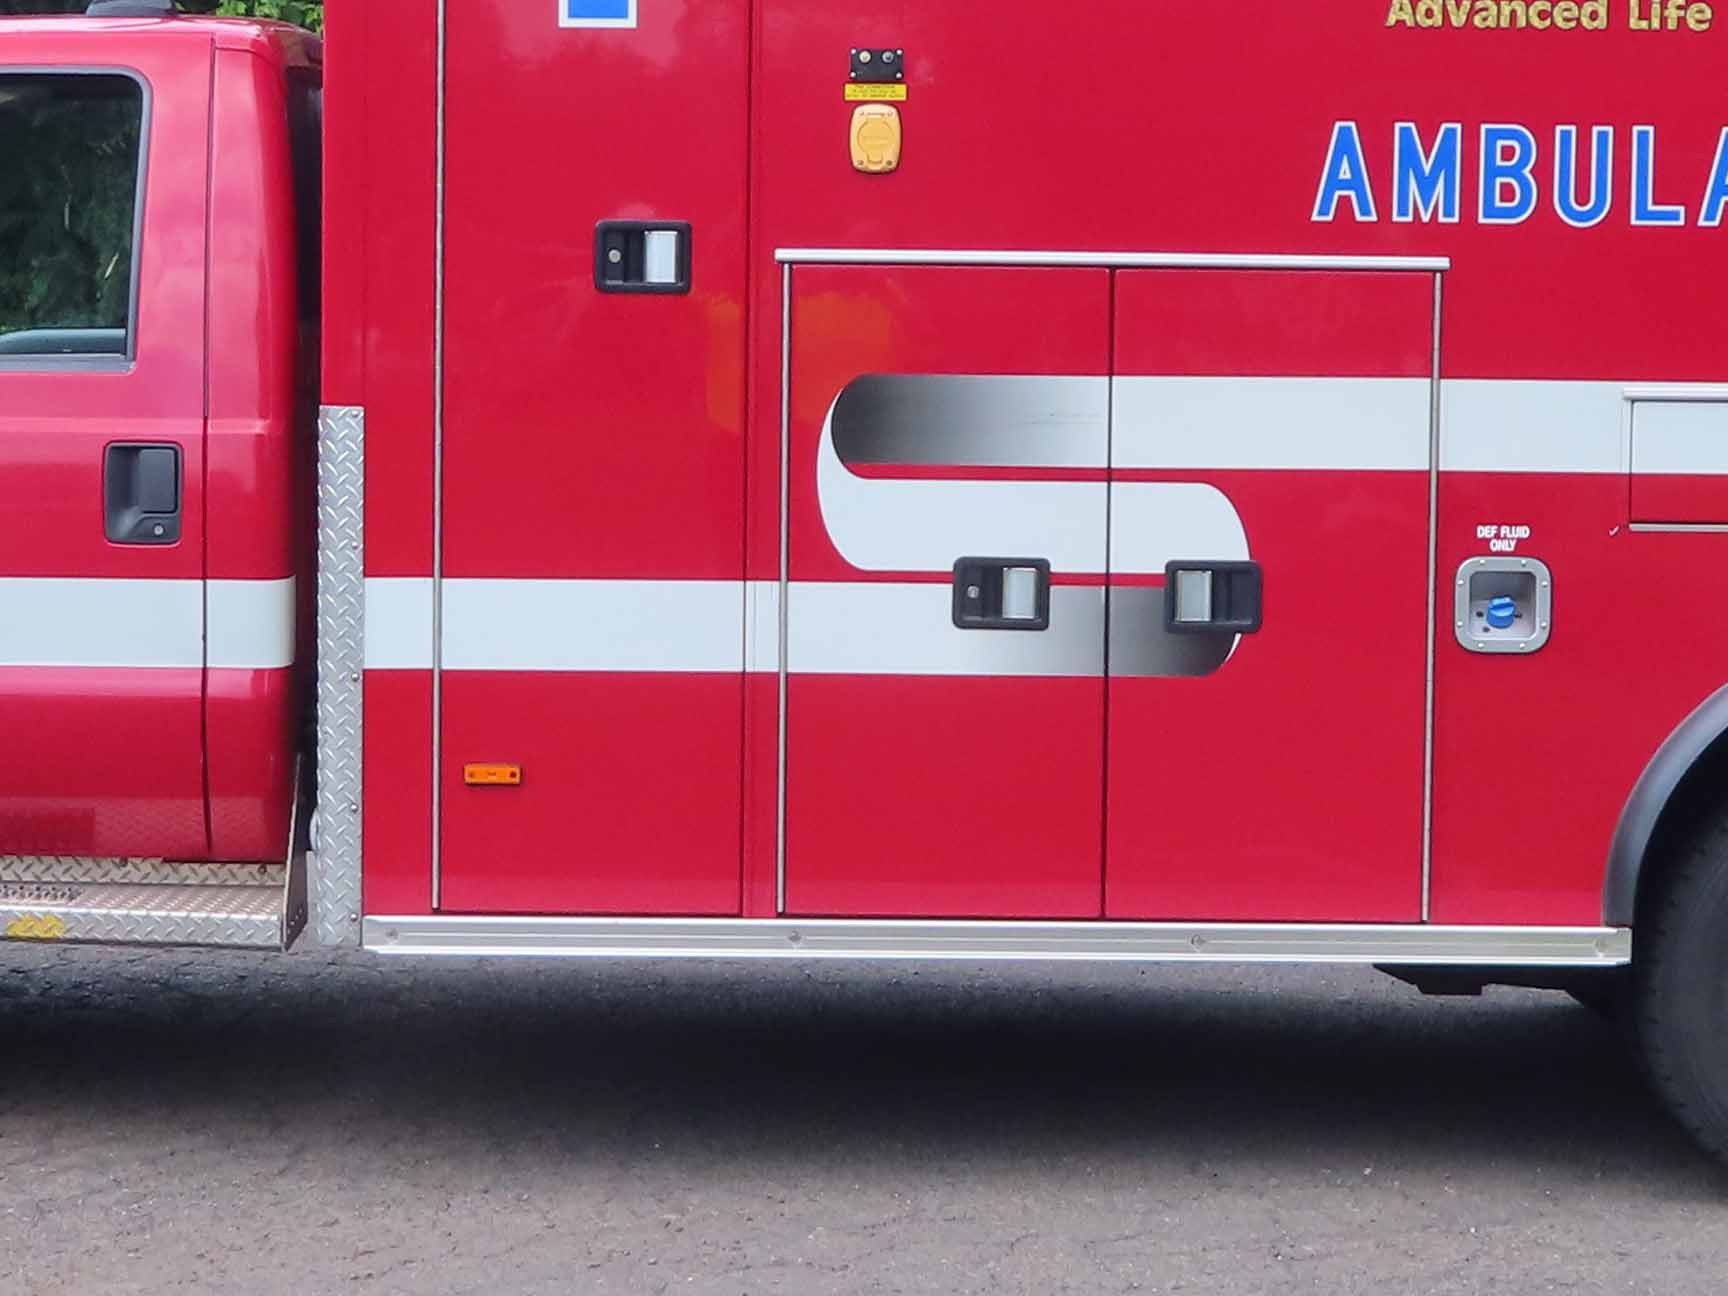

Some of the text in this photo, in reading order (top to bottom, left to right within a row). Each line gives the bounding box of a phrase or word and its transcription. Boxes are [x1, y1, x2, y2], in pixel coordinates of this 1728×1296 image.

[1476, 525, 1530, 538] DEF FLUID
[1489, 539, 1517, 551] ONLY
